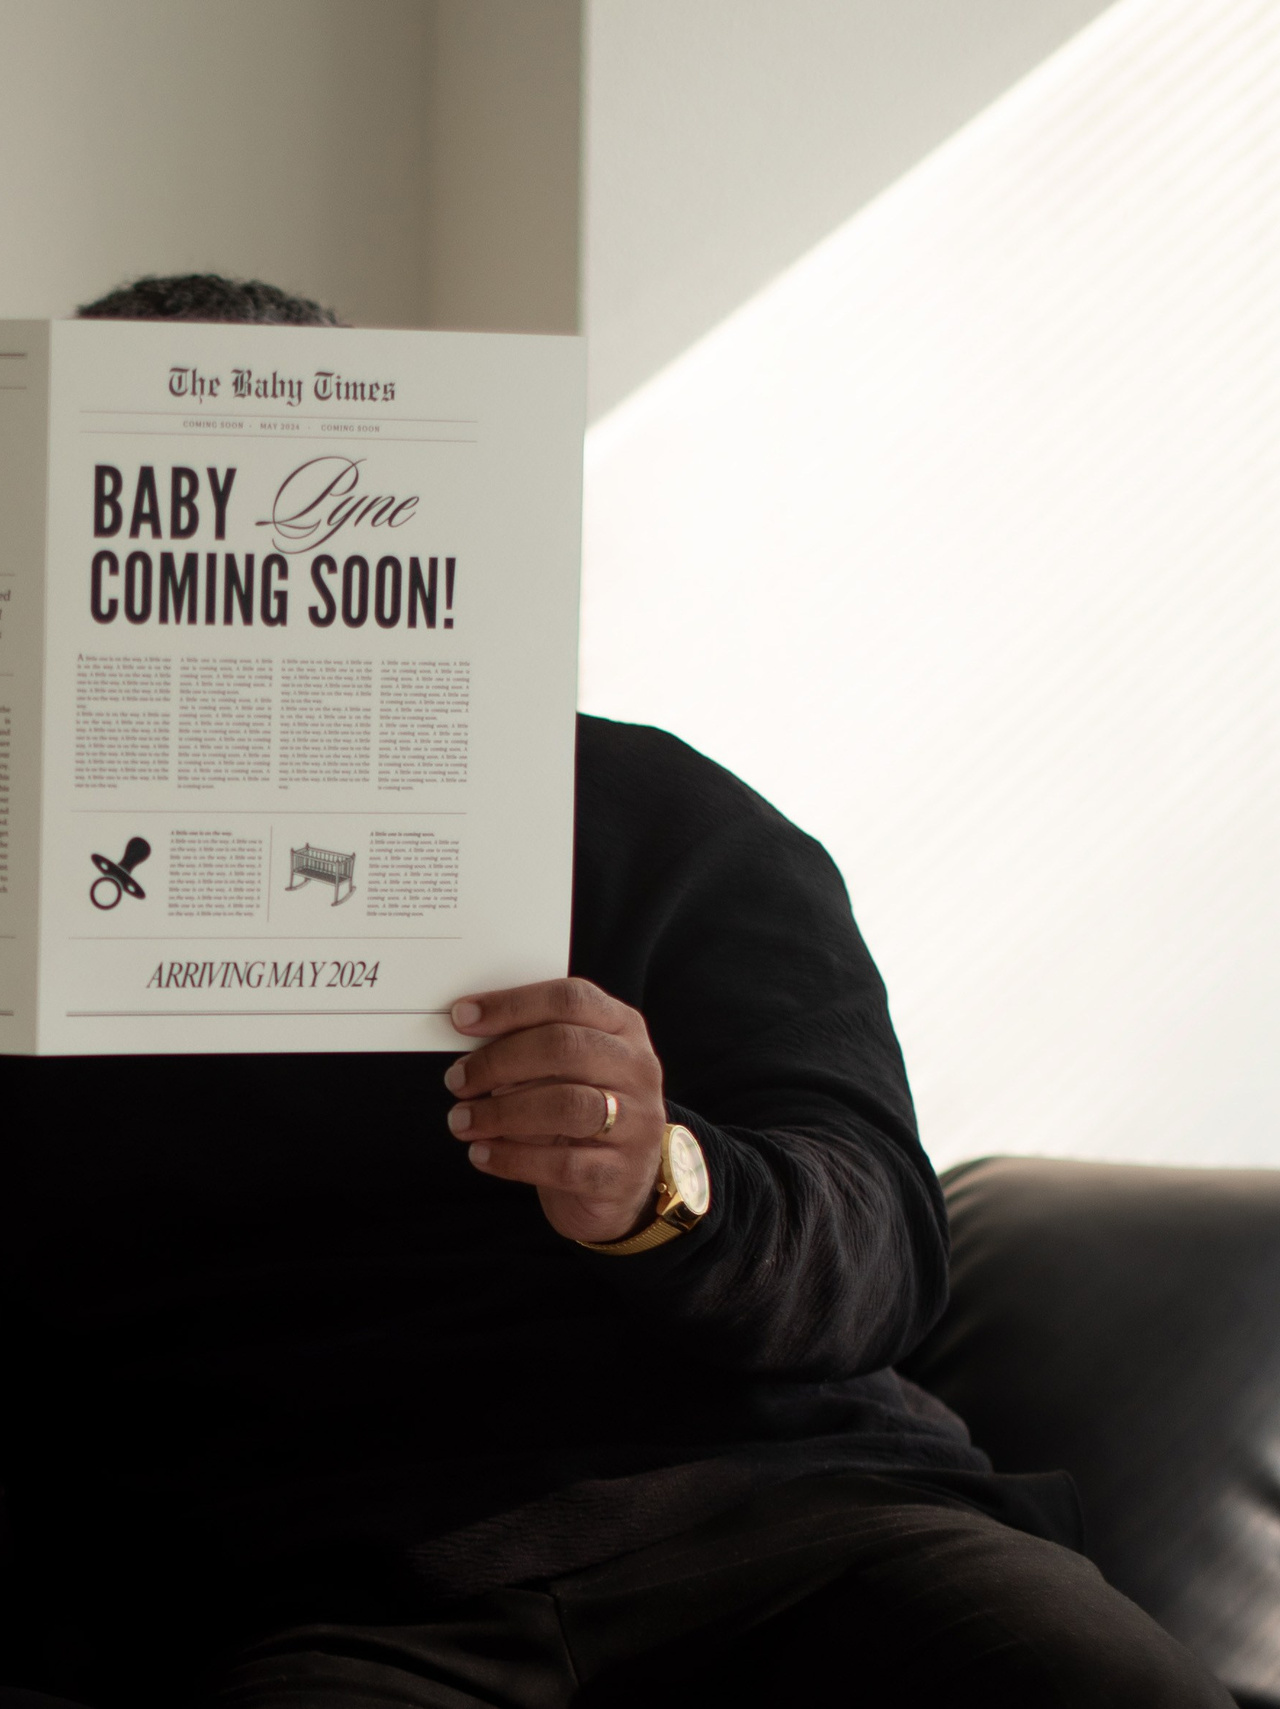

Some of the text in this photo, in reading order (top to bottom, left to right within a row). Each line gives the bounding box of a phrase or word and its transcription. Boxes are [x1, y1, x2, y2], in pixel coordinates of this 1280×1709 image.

[167, 366, 396, 406] The Baby Times
[181, 419, 380, 433] COMING SOON MAY 2024 COMING SOON
[92, 456, 420, 554] BABY Pyne
[89, 550, 456, 628] COMING SOON!
[146, 960, 381, 988] ARRIVING MAY 2024
